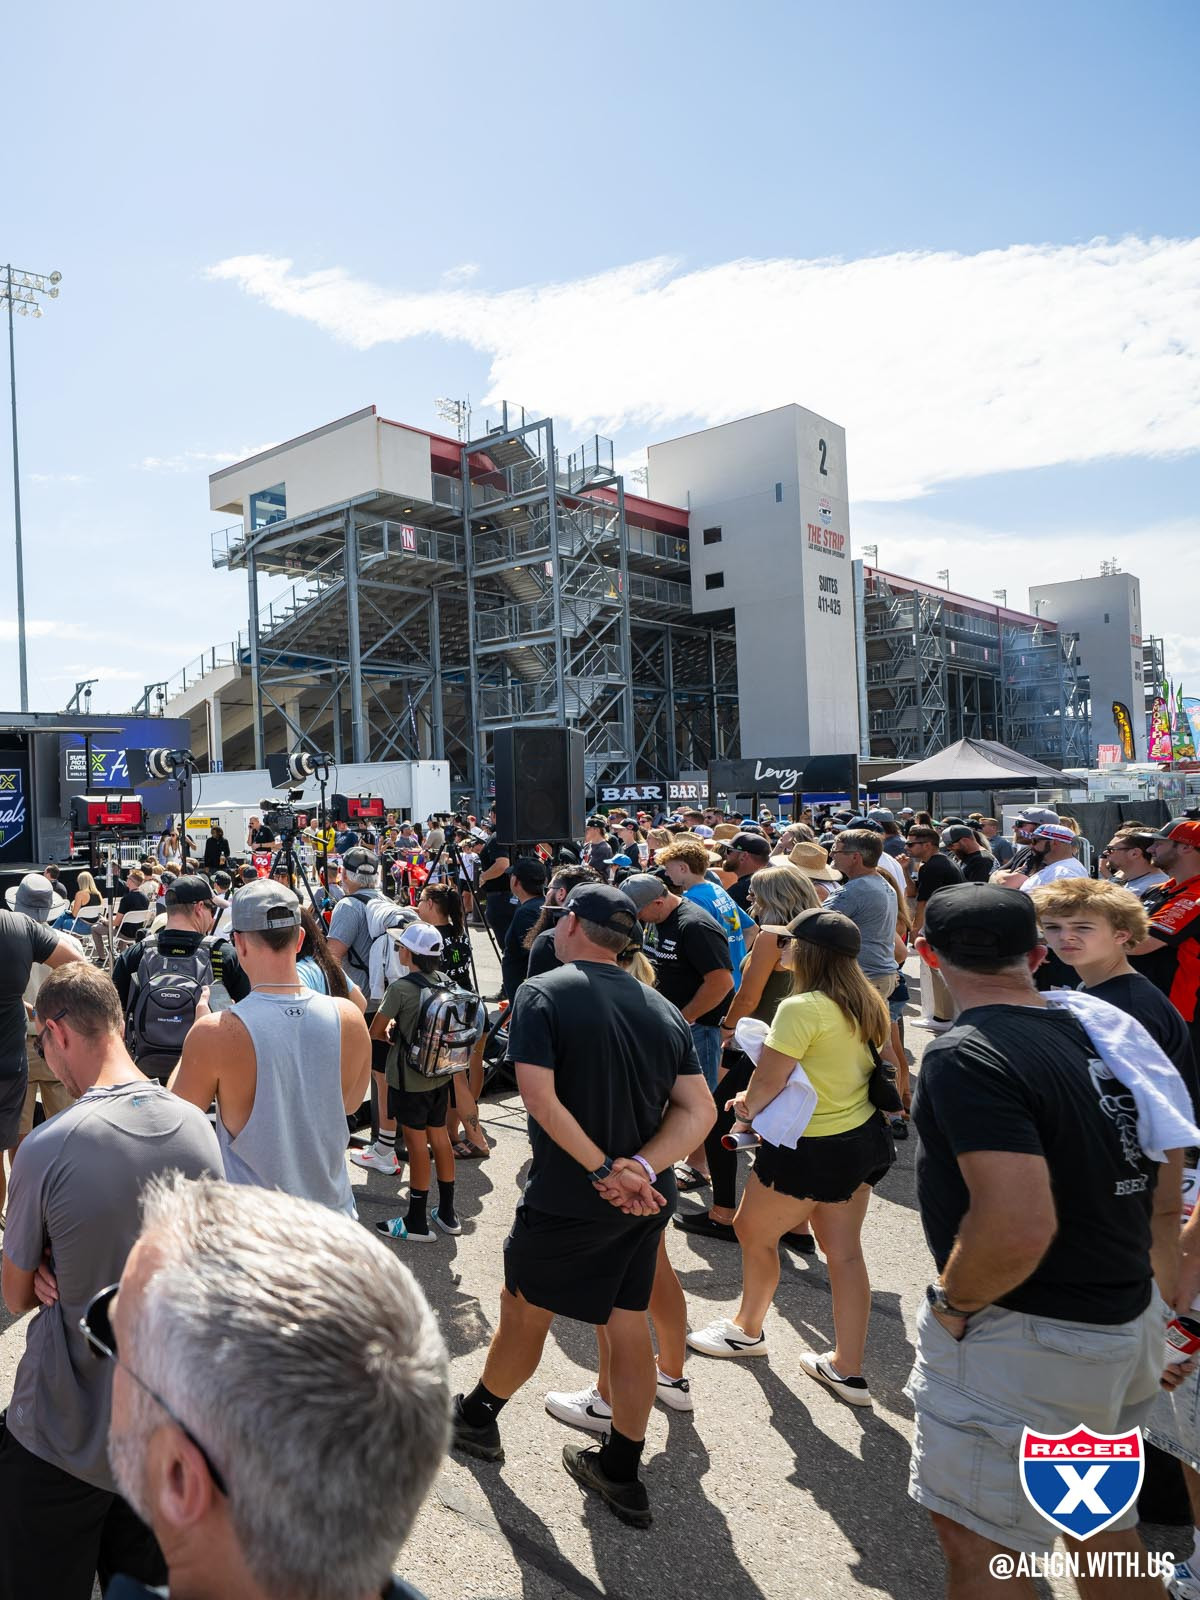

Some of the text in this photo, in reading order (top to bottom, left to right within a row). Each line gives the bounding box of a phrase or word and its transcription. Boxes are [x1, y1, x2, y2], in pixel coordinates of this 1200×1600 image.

[818, 438, 828, 476] 2
[807, 523, 845, 551] THE STRIP
[819, 575, 838, 594] SUITES
[818, 596, 841, 615] 411-425
[754, 761, 803, 790] Levy
[601, 784, 663, 801] BAR
[669, 784, 698, 799] BAR
[255, 856, 269, 866] 96
